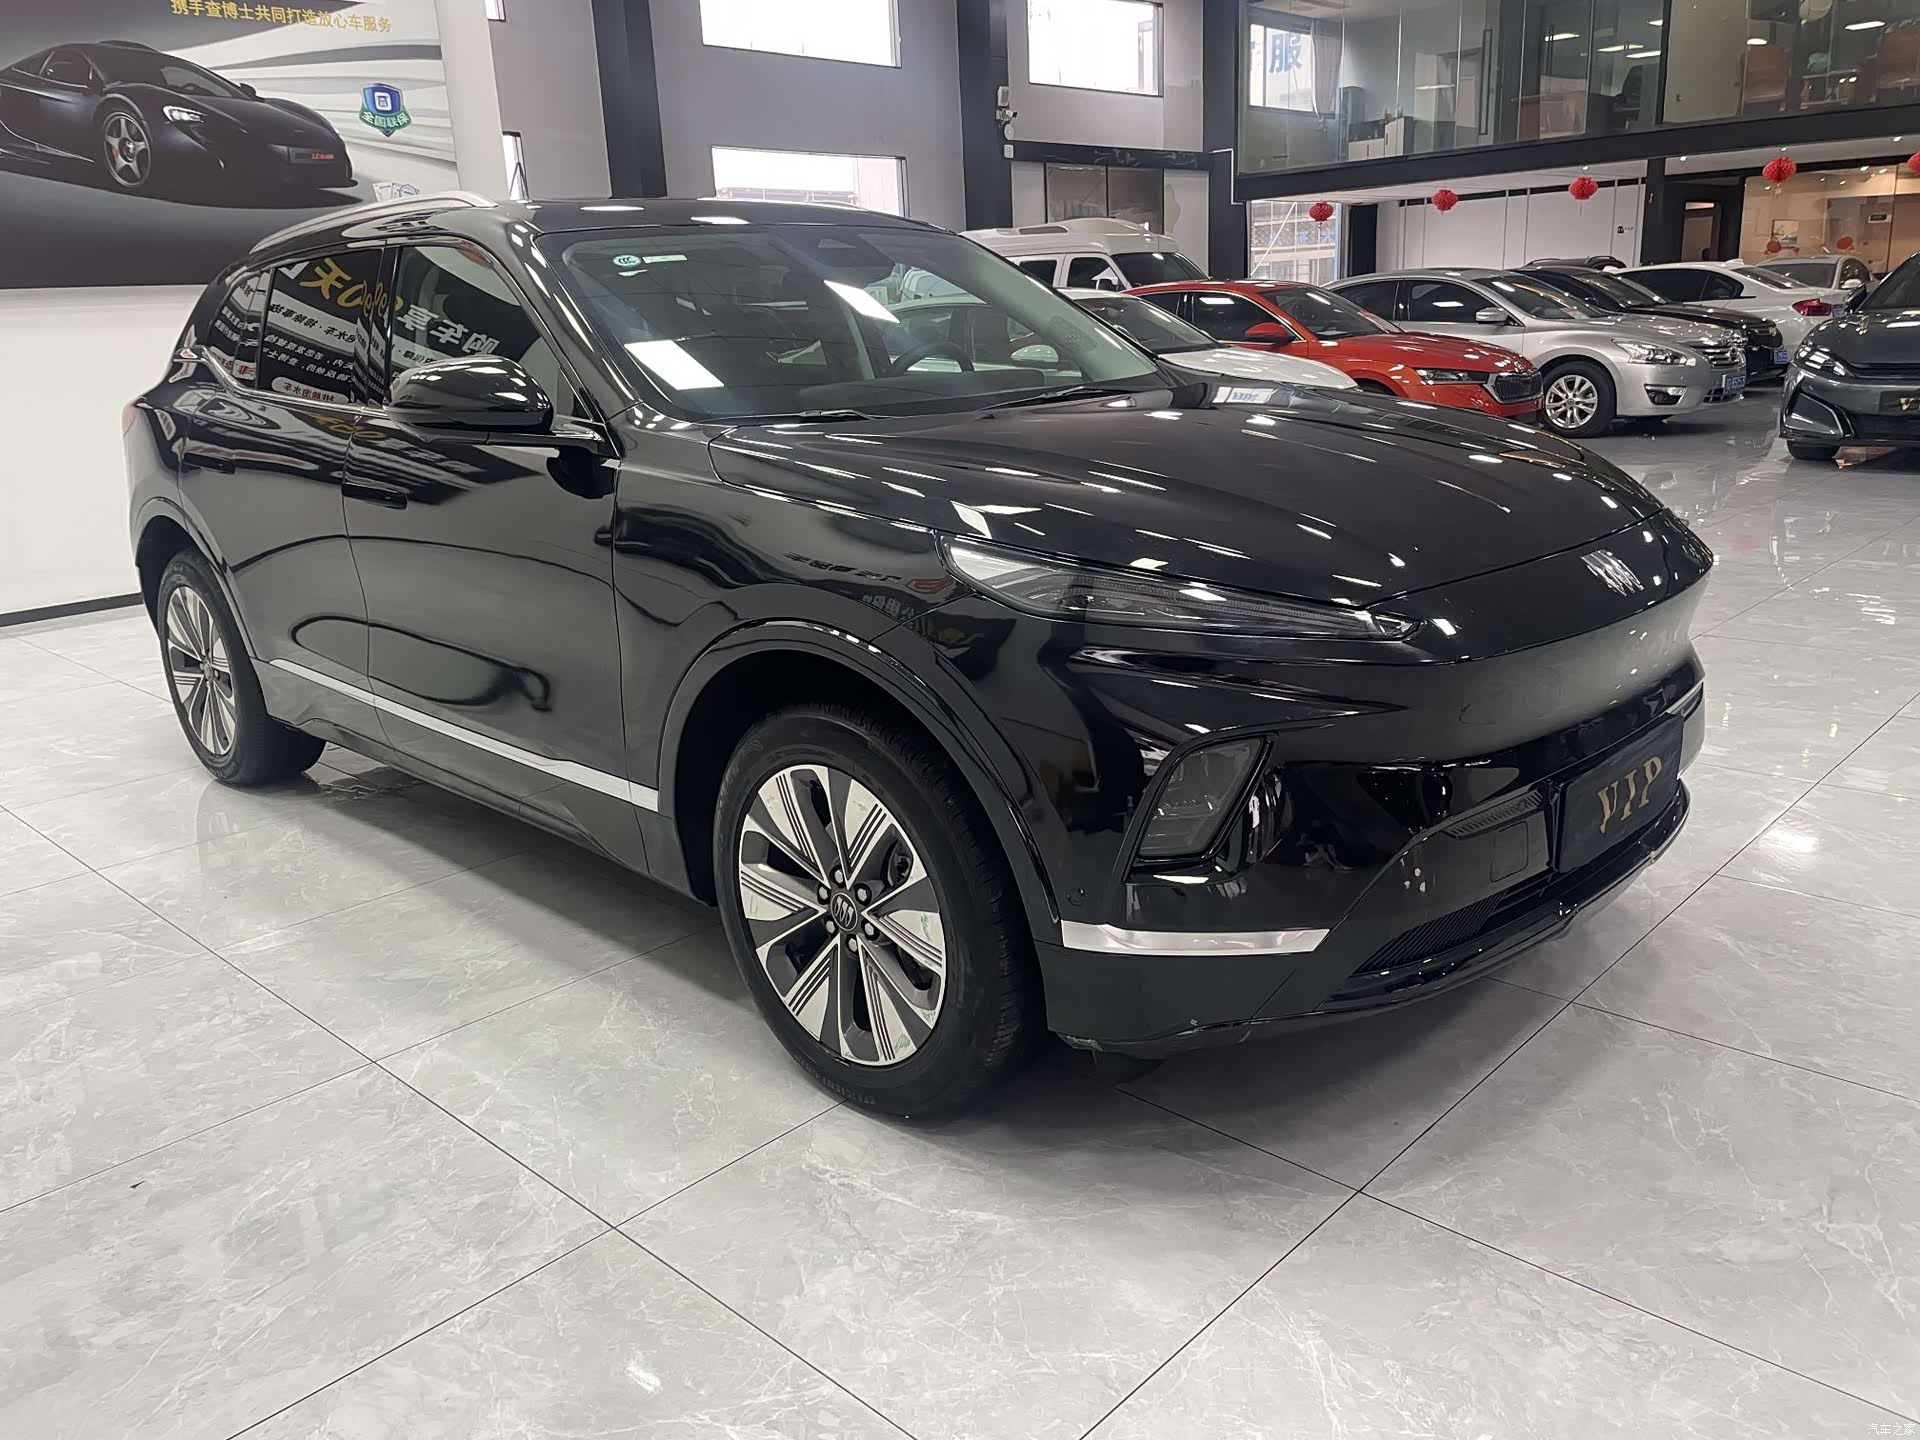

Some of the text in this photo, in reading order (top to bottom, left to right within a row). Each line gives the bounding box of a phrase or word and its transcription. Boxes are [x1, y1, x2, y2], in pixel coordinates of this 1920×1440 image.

[361, 111, 409, 128] 全国联保
[1597, 756, 1663, 834] VIP
